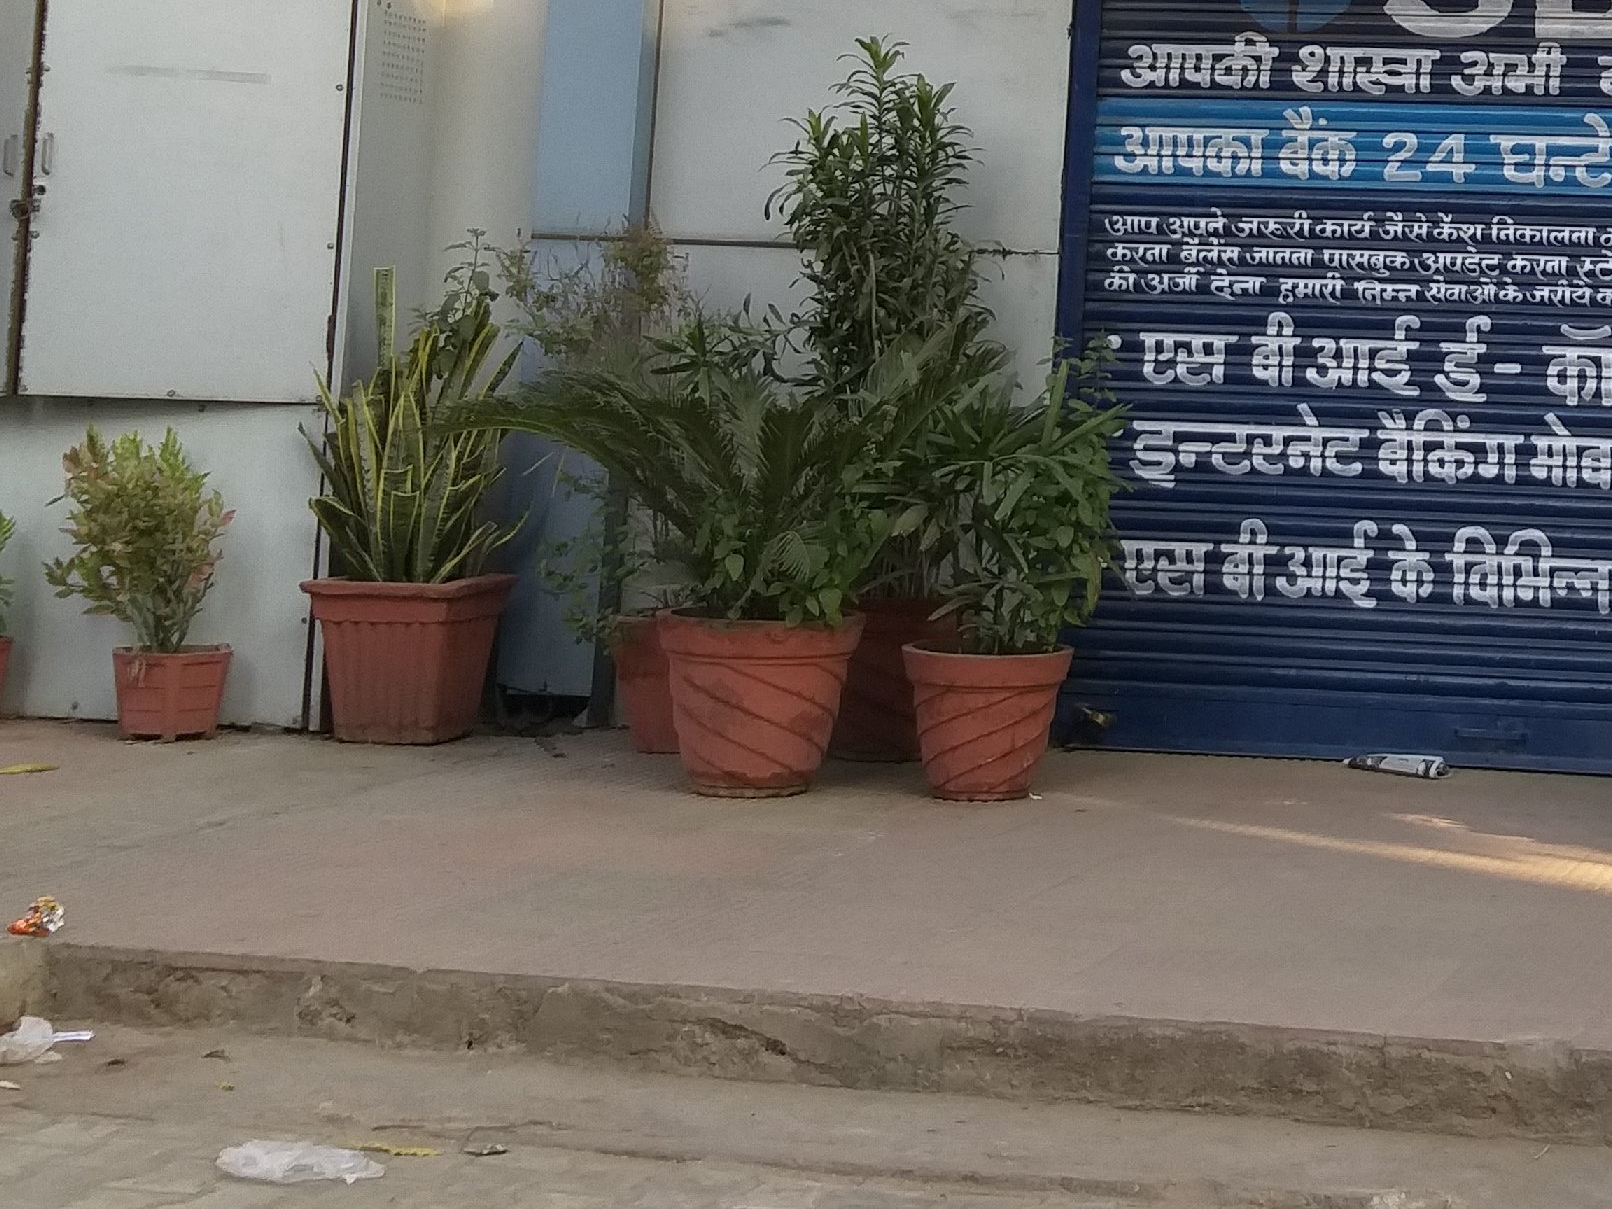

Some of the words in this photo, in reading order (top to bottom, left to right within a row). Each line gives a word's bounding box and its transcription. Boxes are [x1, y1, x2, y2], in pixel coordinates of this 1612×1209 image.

[1120, 31, 1280, 89] आपकी
[1291, 44, 1441, 94] शाखा
[1114, 126, 1269, 177] आपका
[1279, 105, 1357, 181] बैंक
[1382, 132, 1477, 183] 24
[1104, 215, 1159, 236] आप
[1164, 207, 1228, 238] अपने
[1232, 210, 1312, 240] जरूरी
[1315, 211, 1376, 240] कार्य
[1379, 212, 1432, 243] जैसे
[1104, 266, 1138, 293] की
[1211, 268, 1266, 300] देना
[1279, 272, 1346, 304] हमारी
[1498, 277, 1523, 305] के
[1106, 243, 1172, 267] करना
[1323, 248, 1410, 277] पासबुक
[1414, 245, 1502, 277] अपडेट
[1507, 254, 1569, 279] करना
[1139, 332, 1239, 384] एस
[1250, 311, 1302, 387] बी
[1305, 315, 1421, 395] आई
[1129, 403, 1370, 488] इन्टरनेट
[1120, 539, 1214, 596] एस
[1220, 518, 1280, 601] बी
[1275, 519, 1378, 608] आई
[1387, 523, 1436, 604] के
